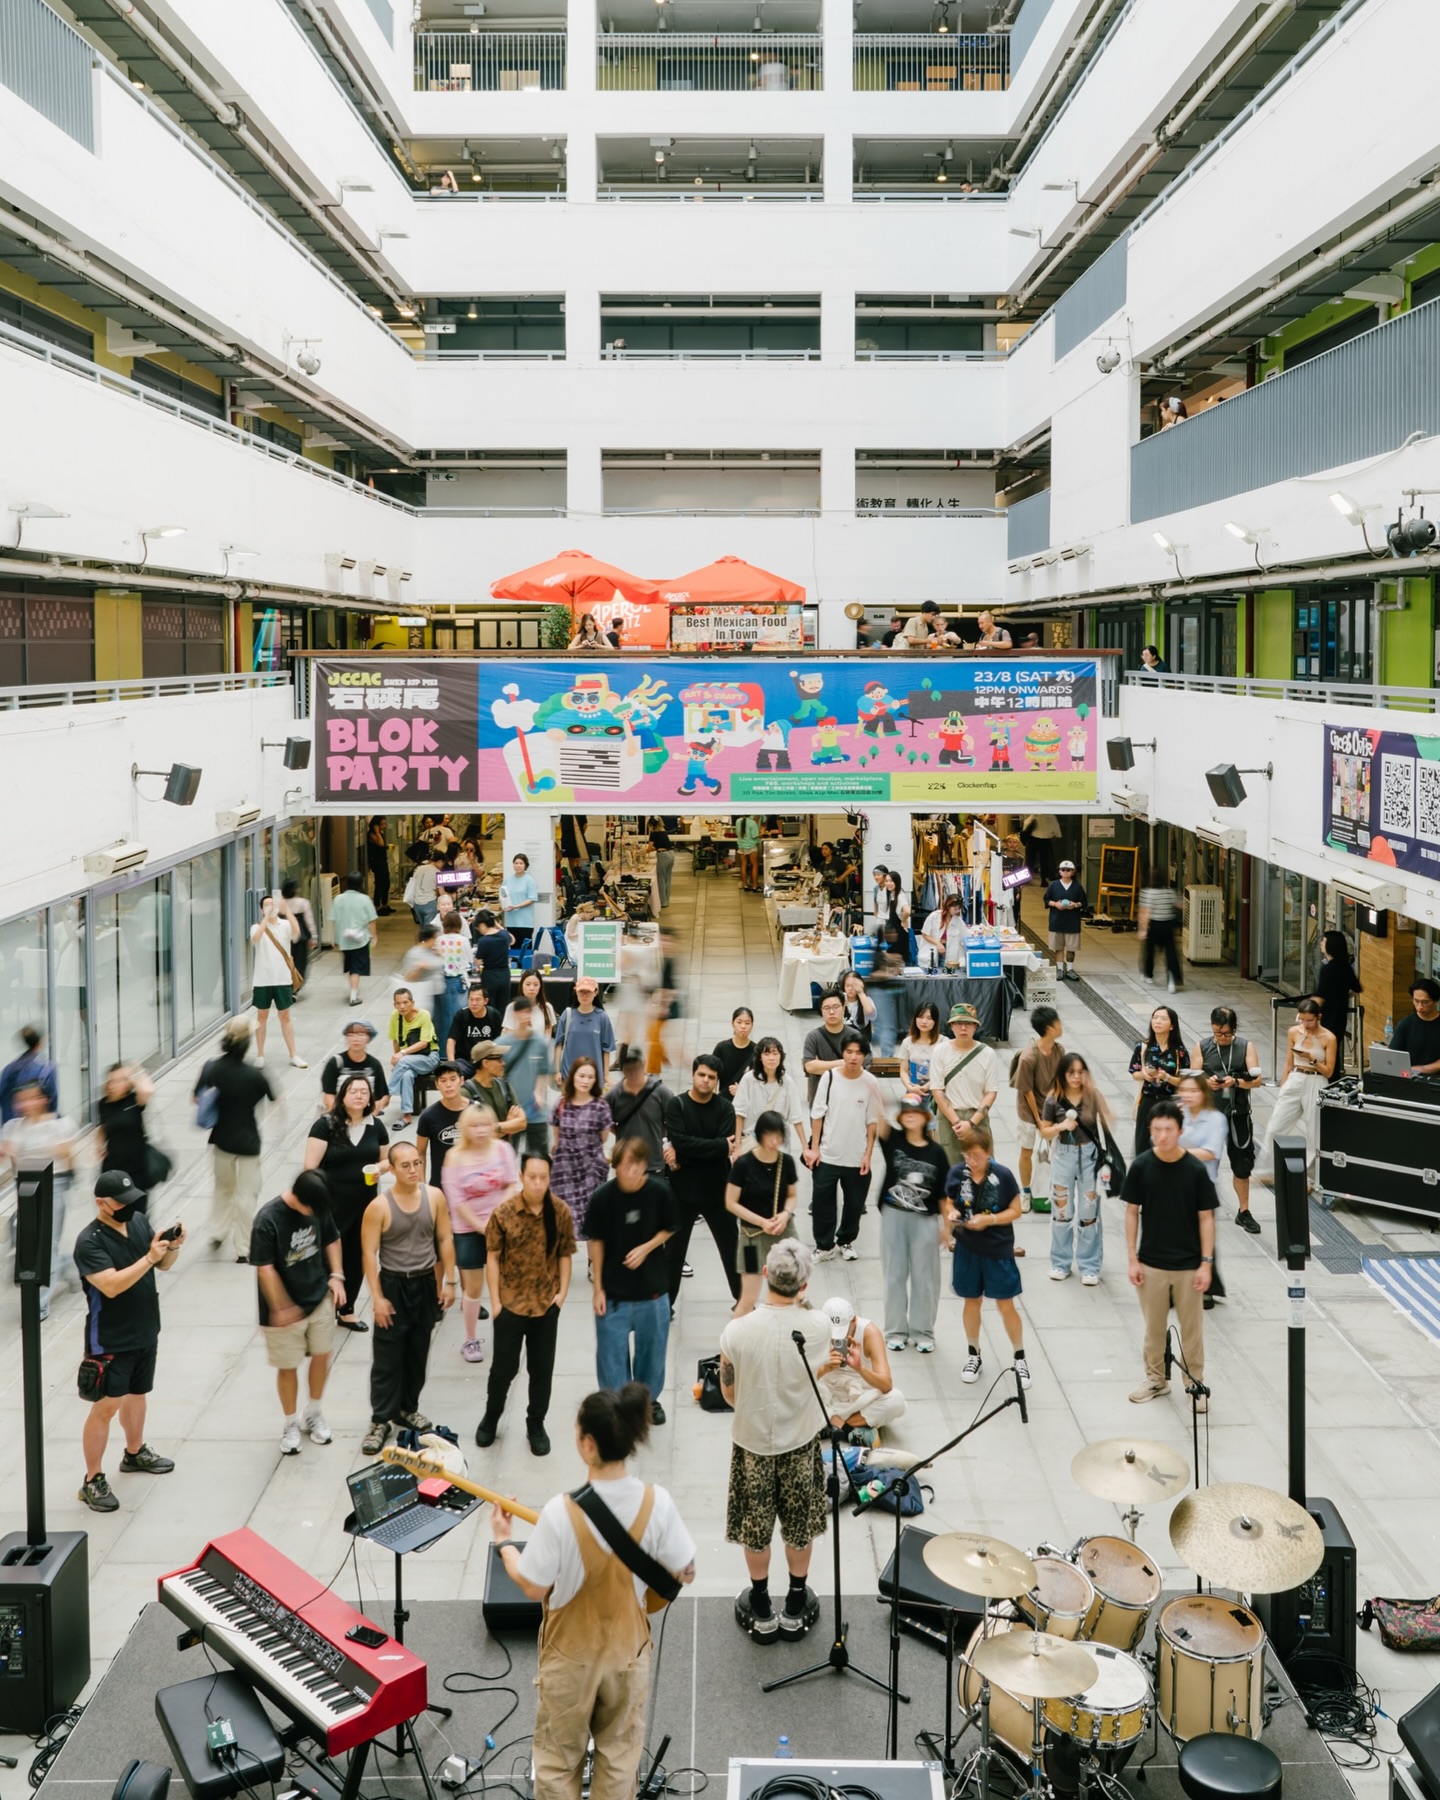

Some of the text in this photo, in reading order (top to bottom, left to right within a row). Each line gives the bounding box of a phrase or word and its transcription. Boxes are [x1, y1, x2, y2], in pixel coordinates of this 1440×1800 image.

[686, 616, 787, 628] Best Mexican Food
[716, 629, 758, 640] In Town
[328, 672, 438, 686] JCCAC SHEK KIP MEI
[974, 671, 1012, 682] 23/8
[1016, 671, 1052, 683] (SAT
[684, 690, 744, 700] ART & CRAFT
[974, 686, 1073, 694] 12PM ONWARDS
[328, 688, 440, 710] 石硤尾
[326, 718, 439, 754] BLOK
[326, 754, 470, 792] PARTY
